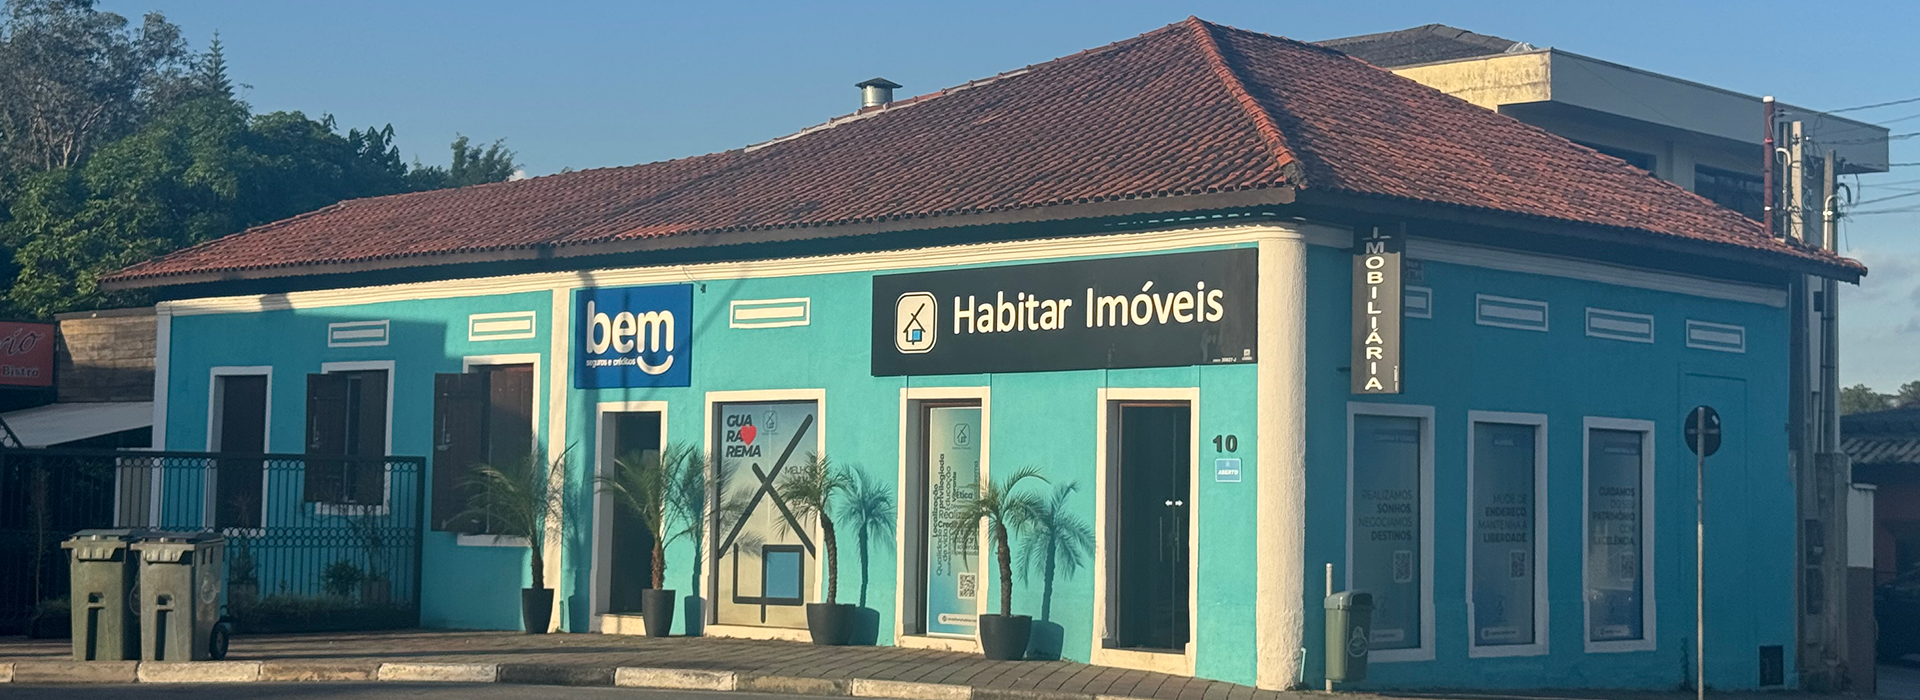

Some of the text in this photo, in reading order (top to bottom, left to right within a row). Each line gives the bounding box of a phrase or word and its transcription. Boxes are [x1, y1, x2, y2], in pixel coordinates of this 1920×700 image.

[953, 280, 1224, 335] Habitar Imóveis
[1365, 226, 1385, 391] IMOBILIÁRIA
[586, 300, 675, 355] bem
[586, 359, 607, 368] seguros
[613, 357, 636, 366] créditos
[726, 414, 752, 427] GUA
[1212, 434, 1238, 453] 10
[725, 445, 761, 457] REMA
[956, 488, 973, 499] Ética
[1361, 489, 1412, 500] REALIZAMOS
[1358, 516, 1412, 527] NEGOCIAMOS
